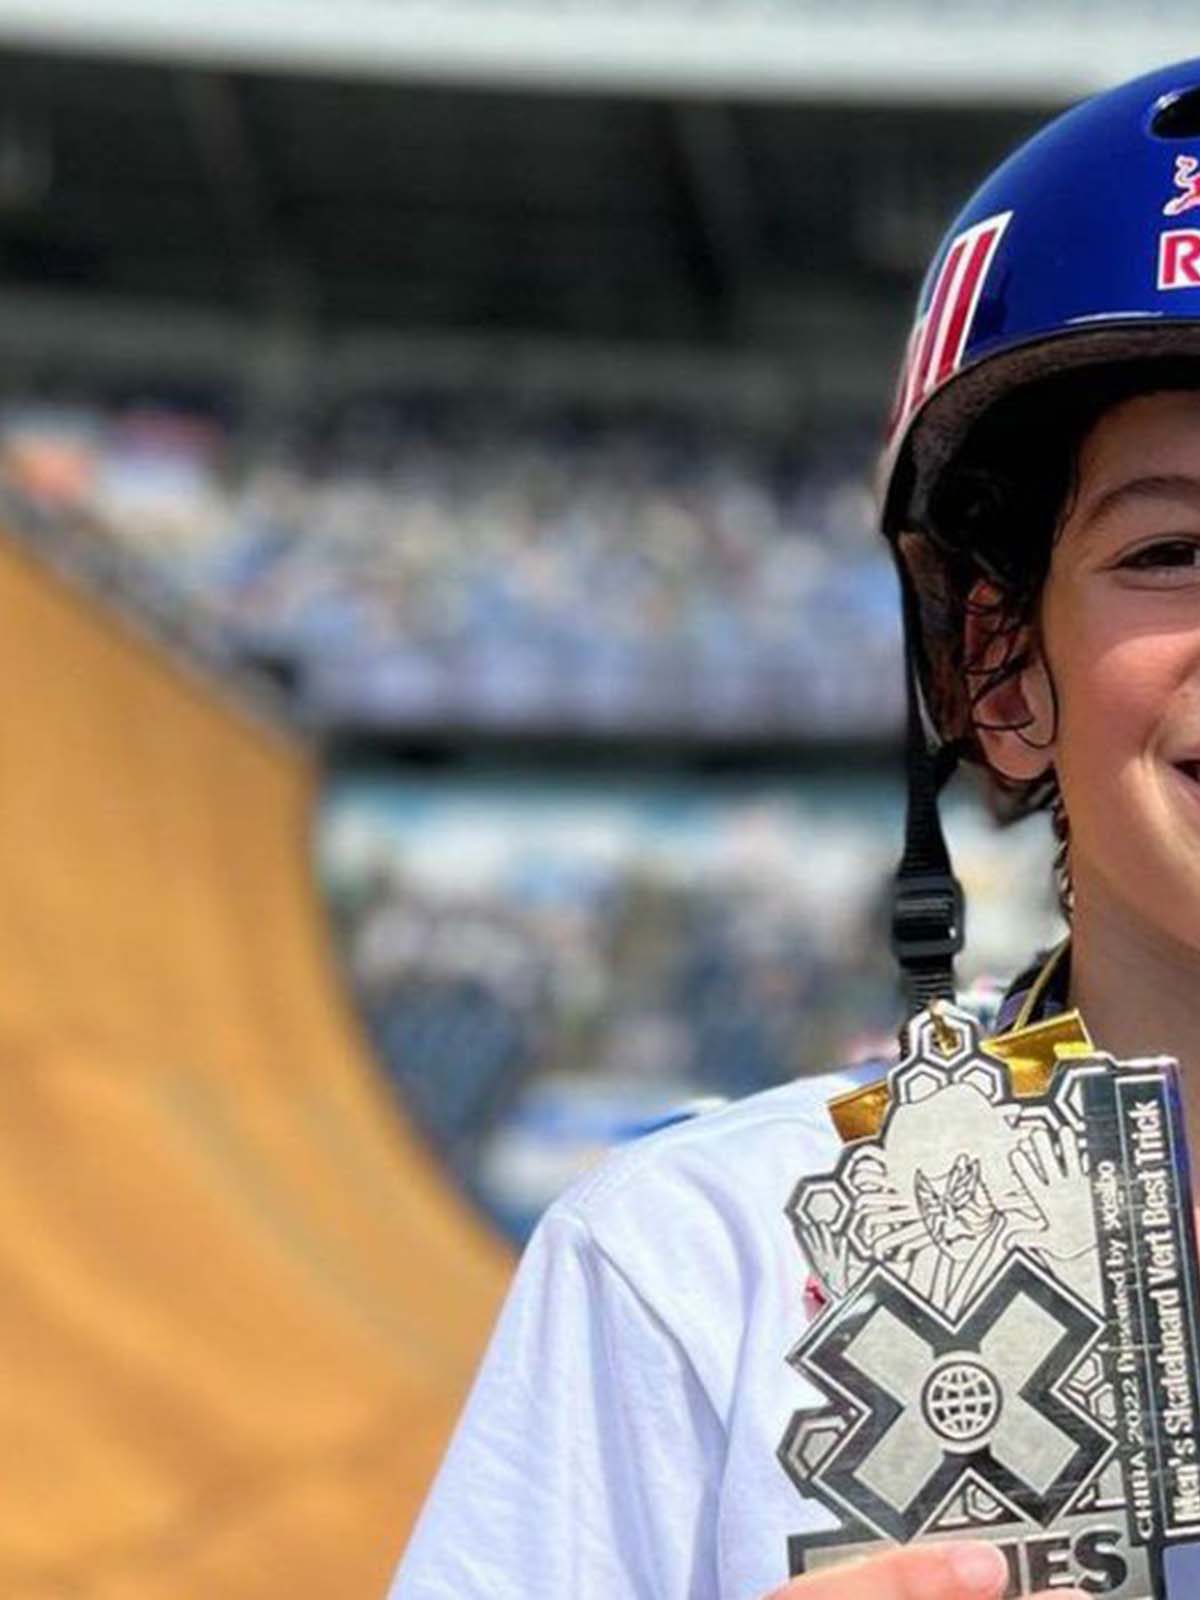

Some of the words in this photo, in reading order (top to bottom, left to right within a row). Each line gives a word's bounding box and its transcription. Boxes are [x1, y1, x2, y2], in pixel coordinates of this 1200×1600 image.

[1128, 1099, 1165, 1165] Trick
[1137, 1165, 1172, 1227] Best
[1105, 1238, 1128, 1268] by
[1144, 1229, 1179, 1285] Vert
[1107, 1271, 1137, 1373] Presented
[1149, 1287, 1194, 1434] Skateboard
[1122, 1376, 1145, 1445] 2022
[1130, 1450, 1154, 1540] CHIBA
